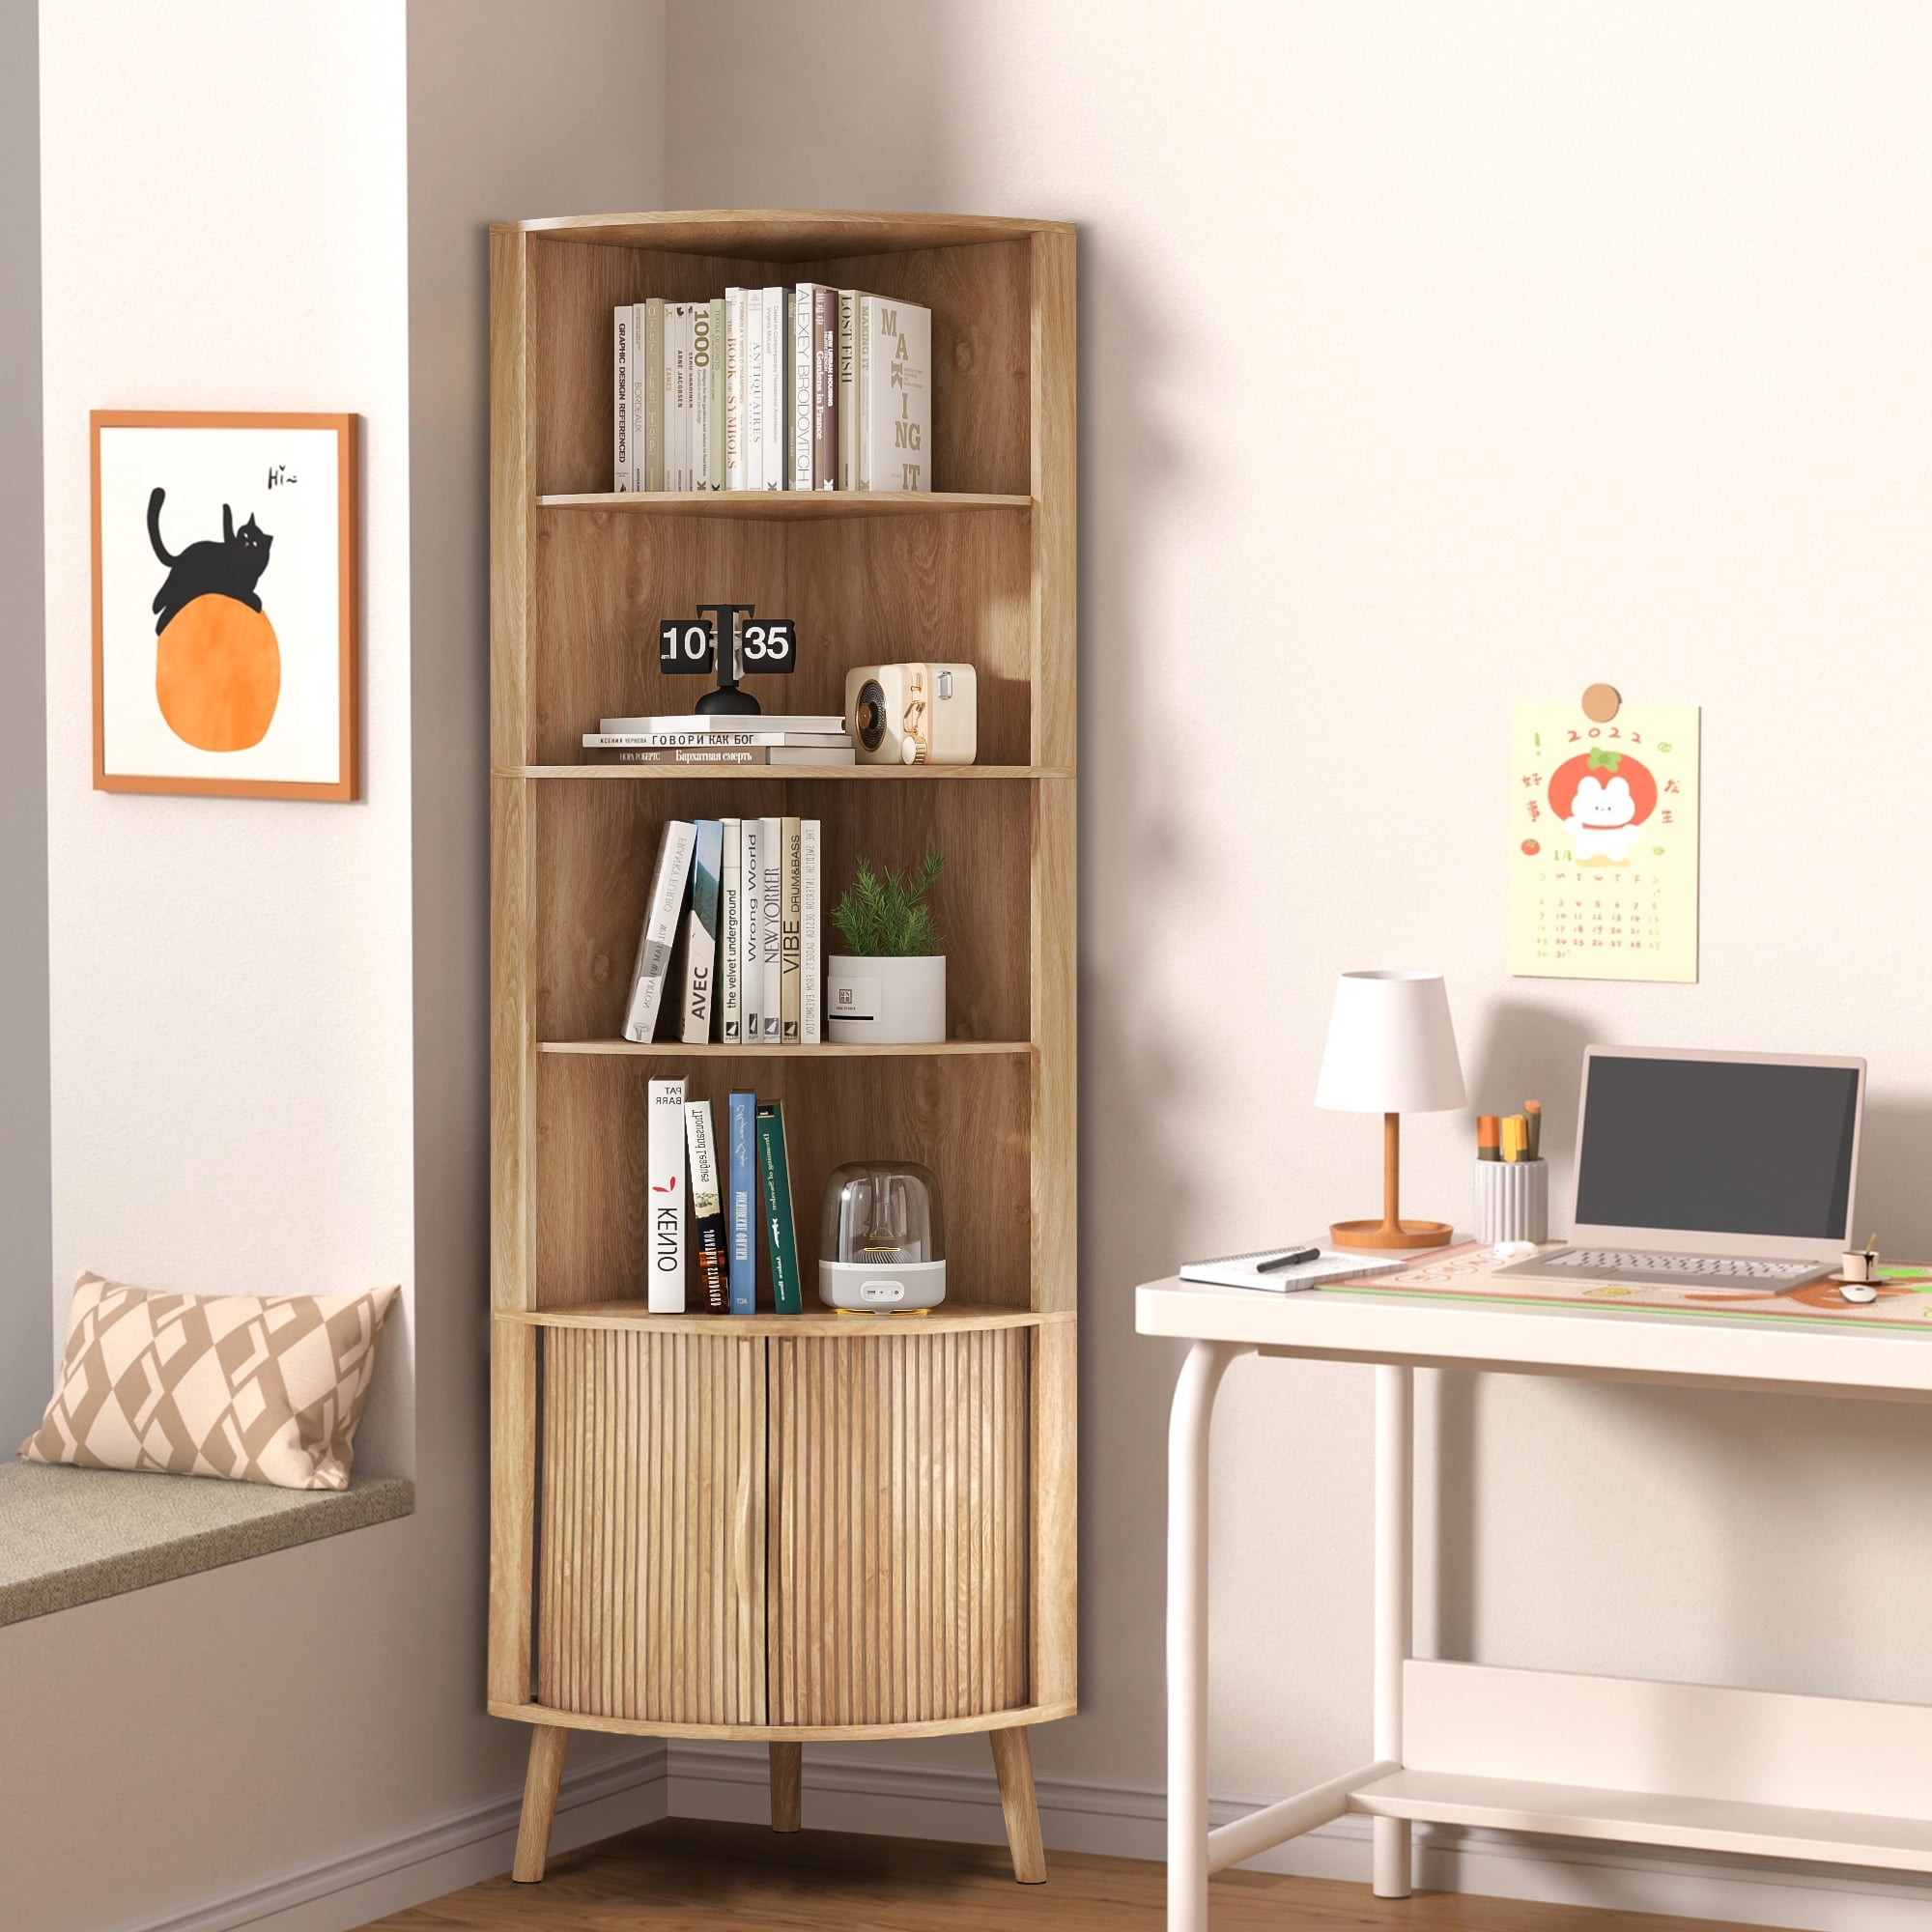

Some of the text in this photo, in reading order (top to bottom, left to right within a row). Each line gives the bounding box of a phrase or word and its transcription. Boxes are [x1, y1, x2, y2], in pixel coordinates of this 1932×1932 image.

[695, 310, 709, 367] 1000
[727, 337, 736, 379] BOOK
[841, 297, 852, 384] LOST FISH
[798, 290, 810, 481] ALEXEY BRODOVITCH
[862, 358, 869, 371] IT
[752, 343, 761, 442] ANTIQUAIRES
[816, 394, 824, 404] in
[727, 396, 737, 469] SYMBOLS
[902, 464, 920, 491] IT
[663, 626, 705, 660] 10
[744, 626, 788, 660] 35
[652, 735, 703, 745] ГОВОРИ
[709, 735, 729, 745] КАК
[734, 734, 754, 745] БОГ
[676, 750, 721, 763] Бархатная
[723, 752, 752, 763] смерть
[1567, 726, 1642, 744] 2022
[748, 835, 757, 962] Wrong World
[1615, 873, 1621, 882] T
[764, 867, 780, 963] NEW YORKER
[783, 835, 800, 974] VIBE DRUM&BASS
[726, 890, 738, 1009] the velvet underground
[692, 966, 708, 1020] AVEC
